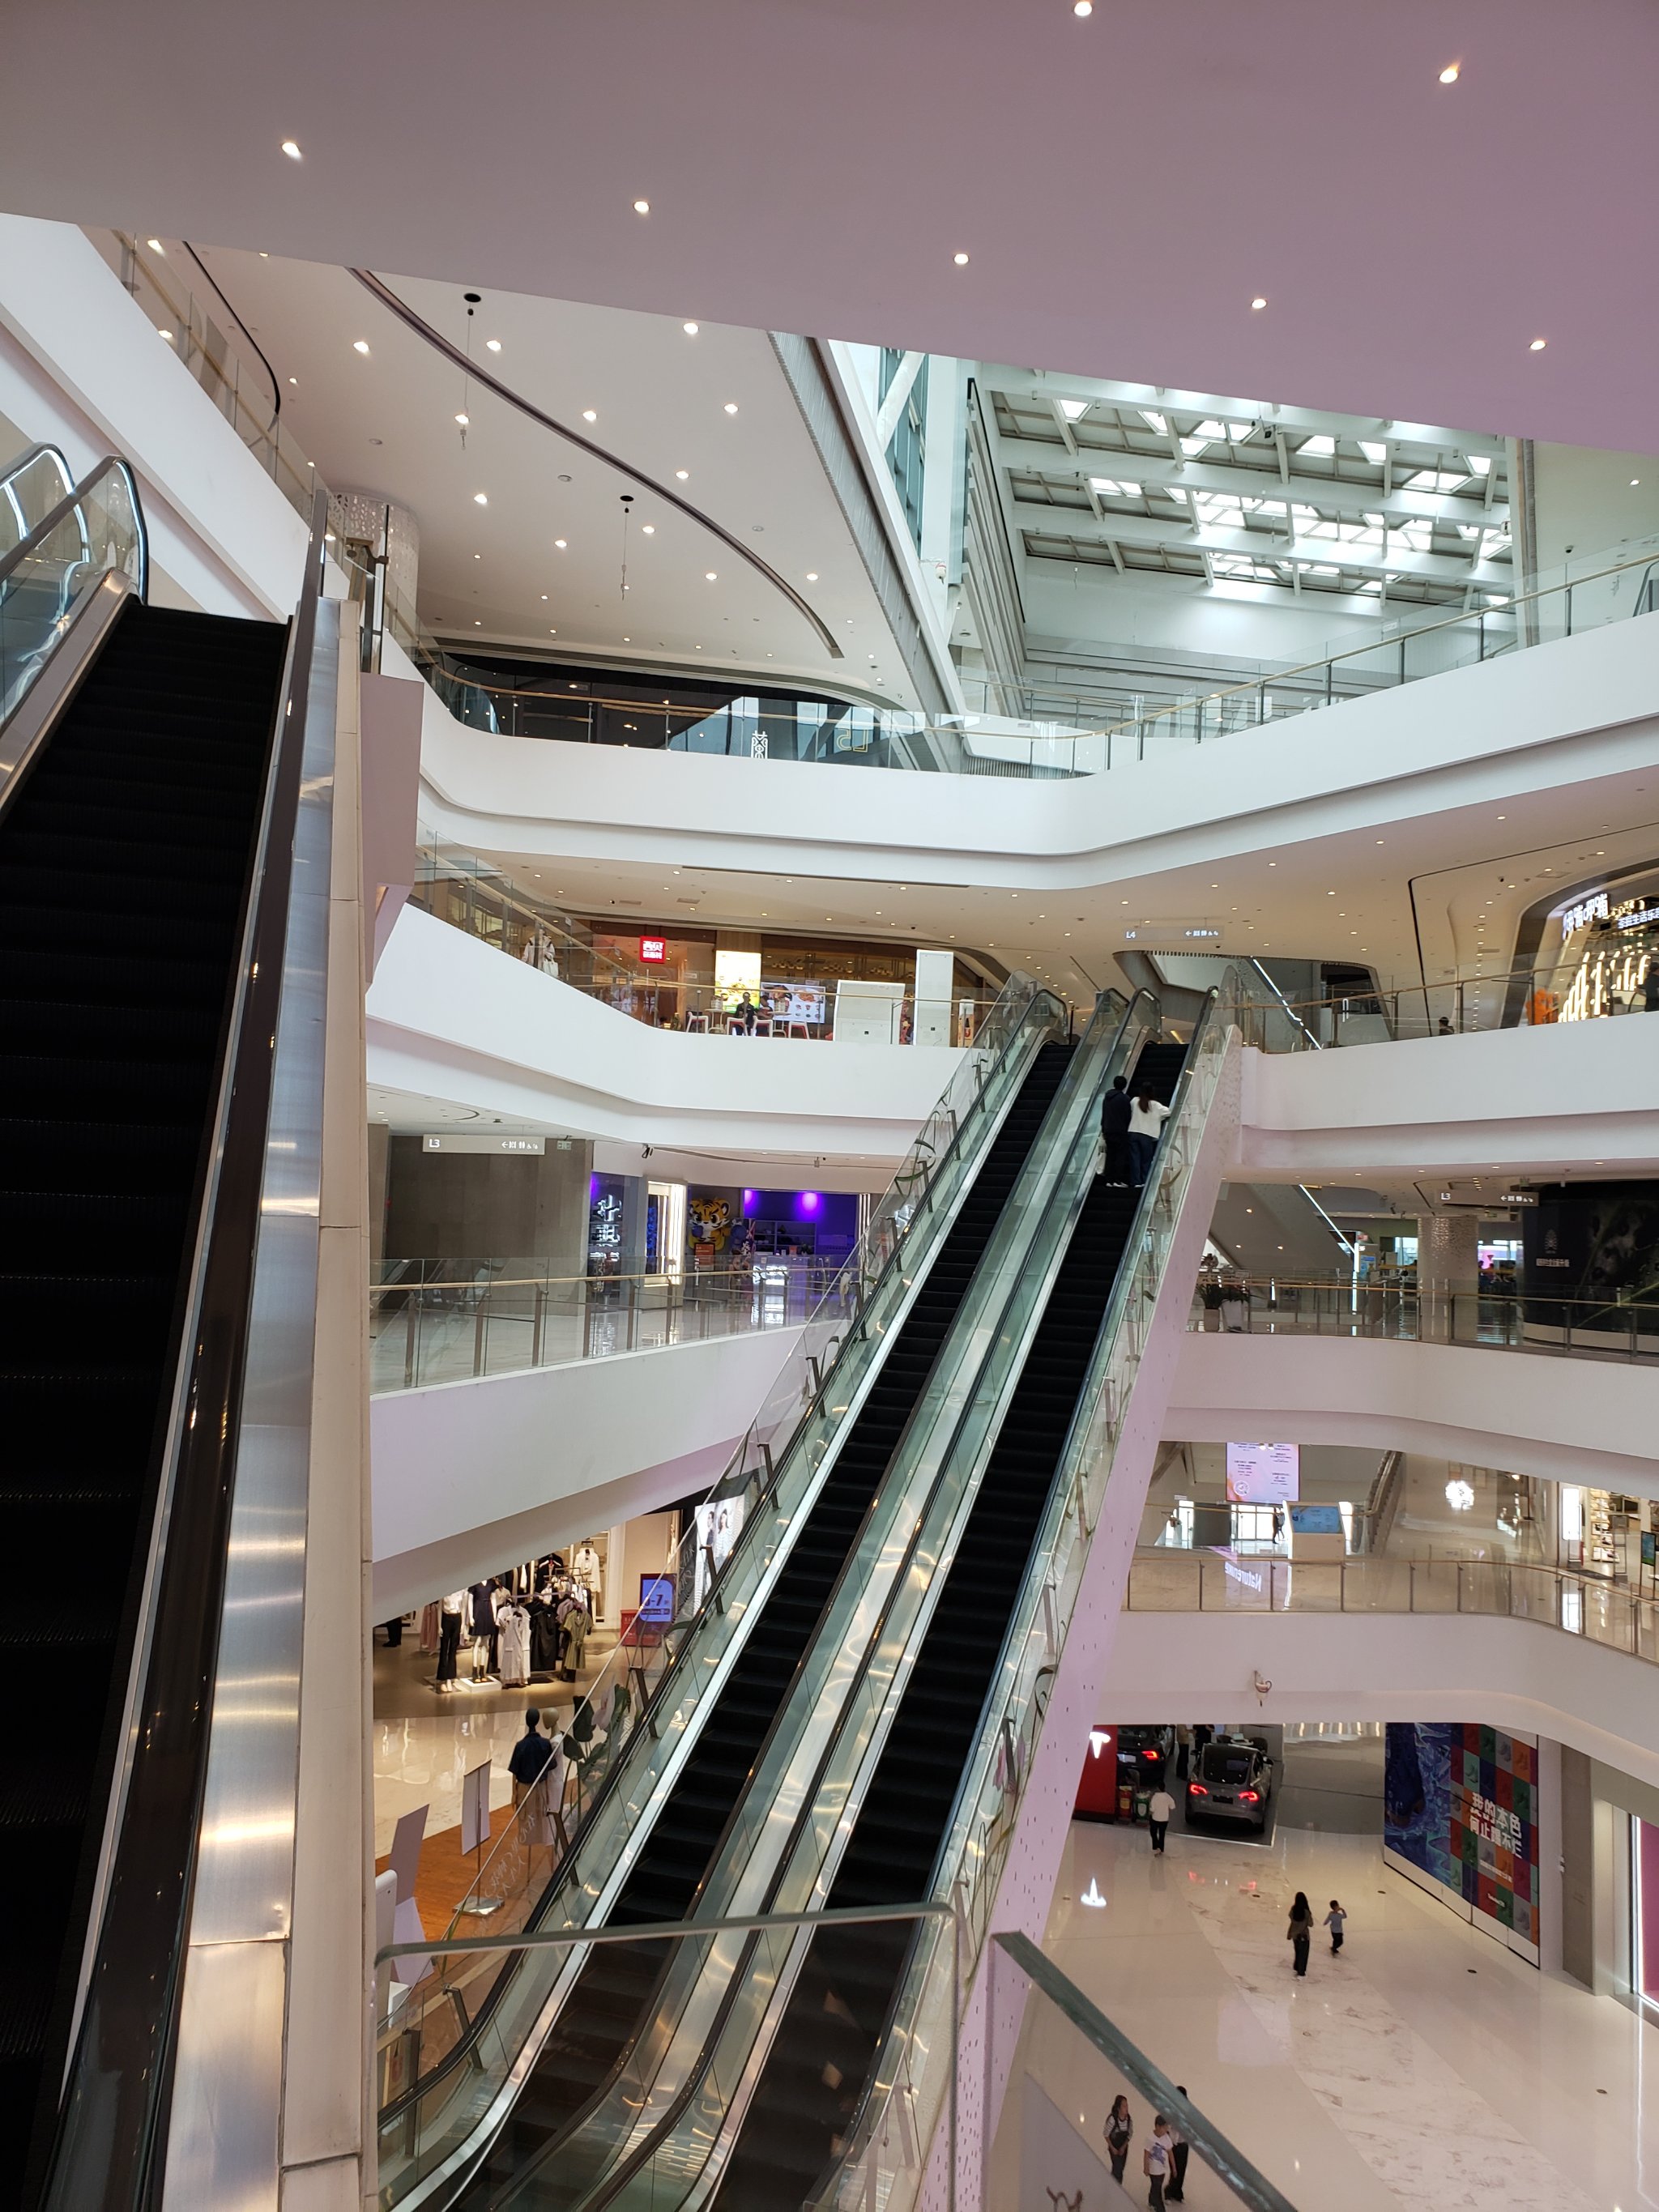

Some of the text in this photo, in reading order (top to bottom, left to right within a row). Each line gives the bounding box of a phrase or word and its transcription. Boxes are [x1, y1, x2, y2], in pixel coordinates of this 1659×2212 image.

[1126, 931, 1136, 939] L4
[429, 1139, 441, 1149] L3
[1441, 1192, 1451, 1200] L3
[1470, 1792, 1522, 1839] 我的本色
